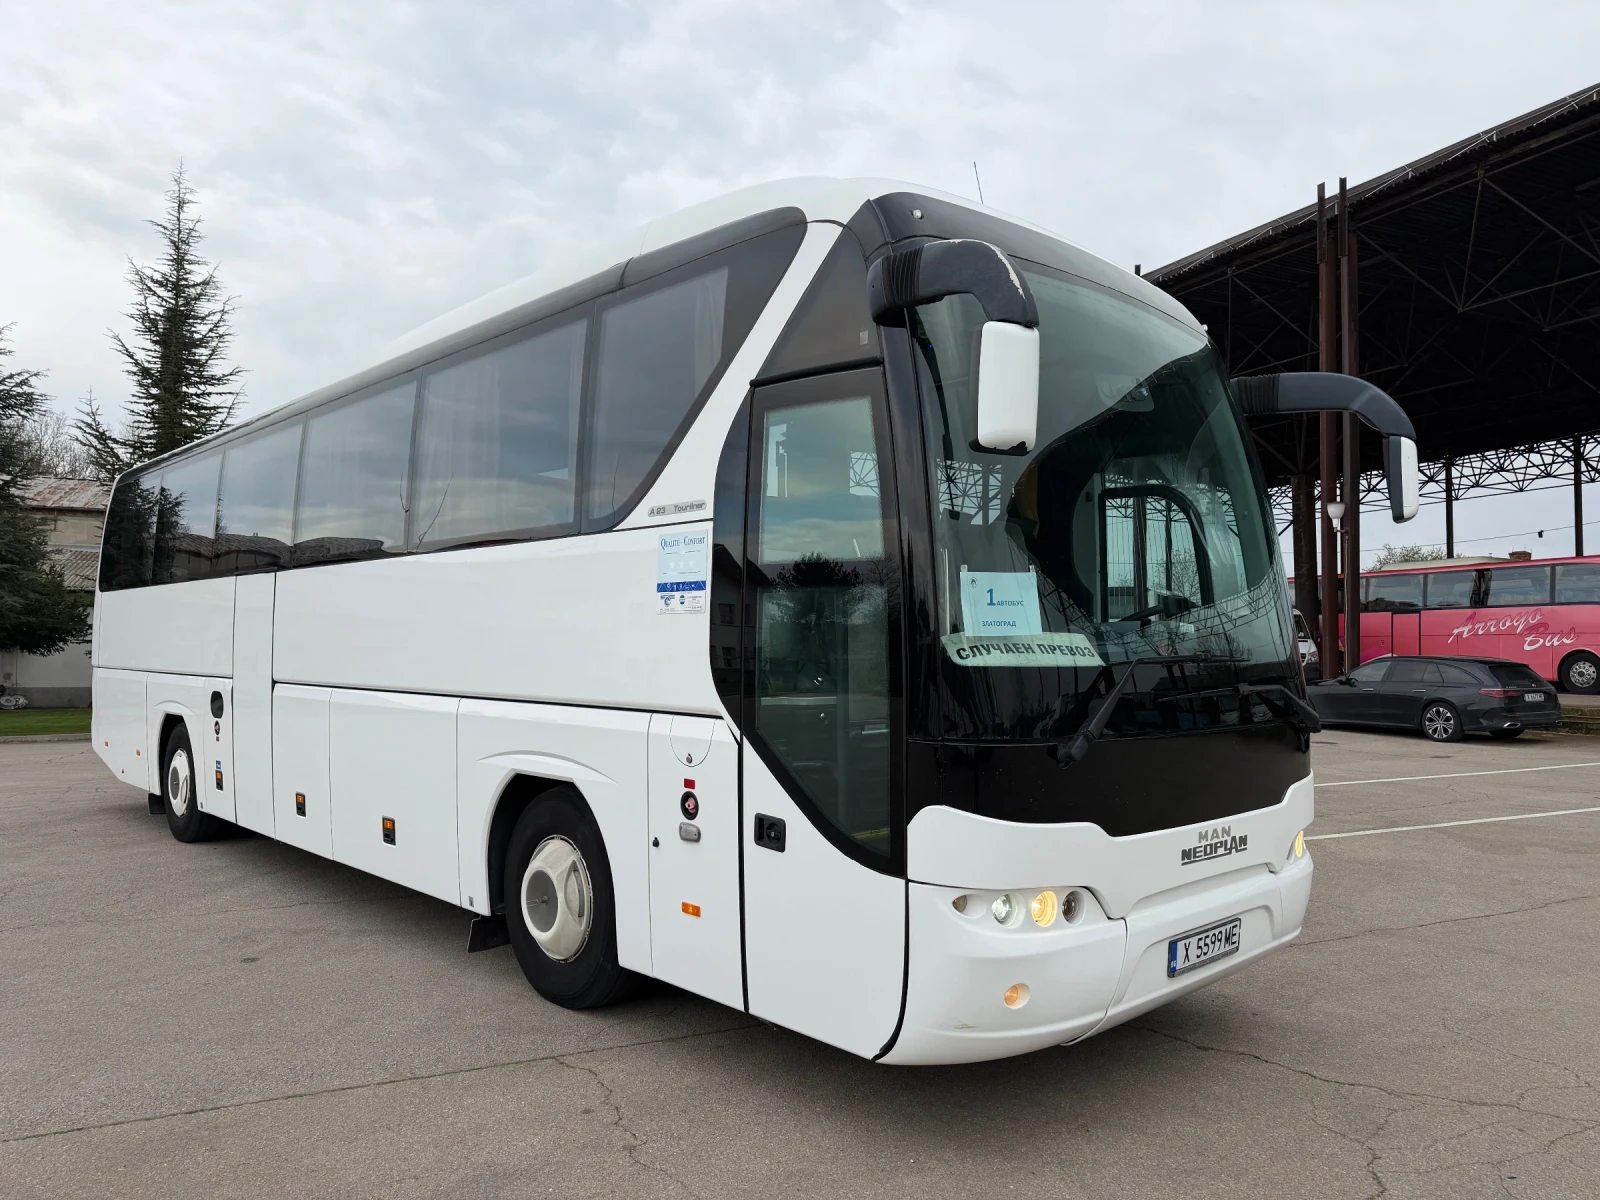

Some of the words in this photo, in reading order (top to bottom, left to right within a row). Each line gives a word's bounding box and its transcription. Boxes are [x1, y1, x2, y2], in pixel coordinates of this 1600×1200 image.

[673, 502, 706, 512] Tourliner
[981, 620, 1017, 628] ЗЛАТОГРАД
[1447, 608, 1545, 644] Arroyo
[1522, 622, 1579, 651] Bus
[956, 643, 1035, 660] СЛУЧАЕН
[1036, 644, 1095, 658] ПРЕВОЗ
[1198, 825, 1232, 844] MAN
[1181, 834, 1248, 866] NEOPLAN
[1182, 941, 1192, 965] X
